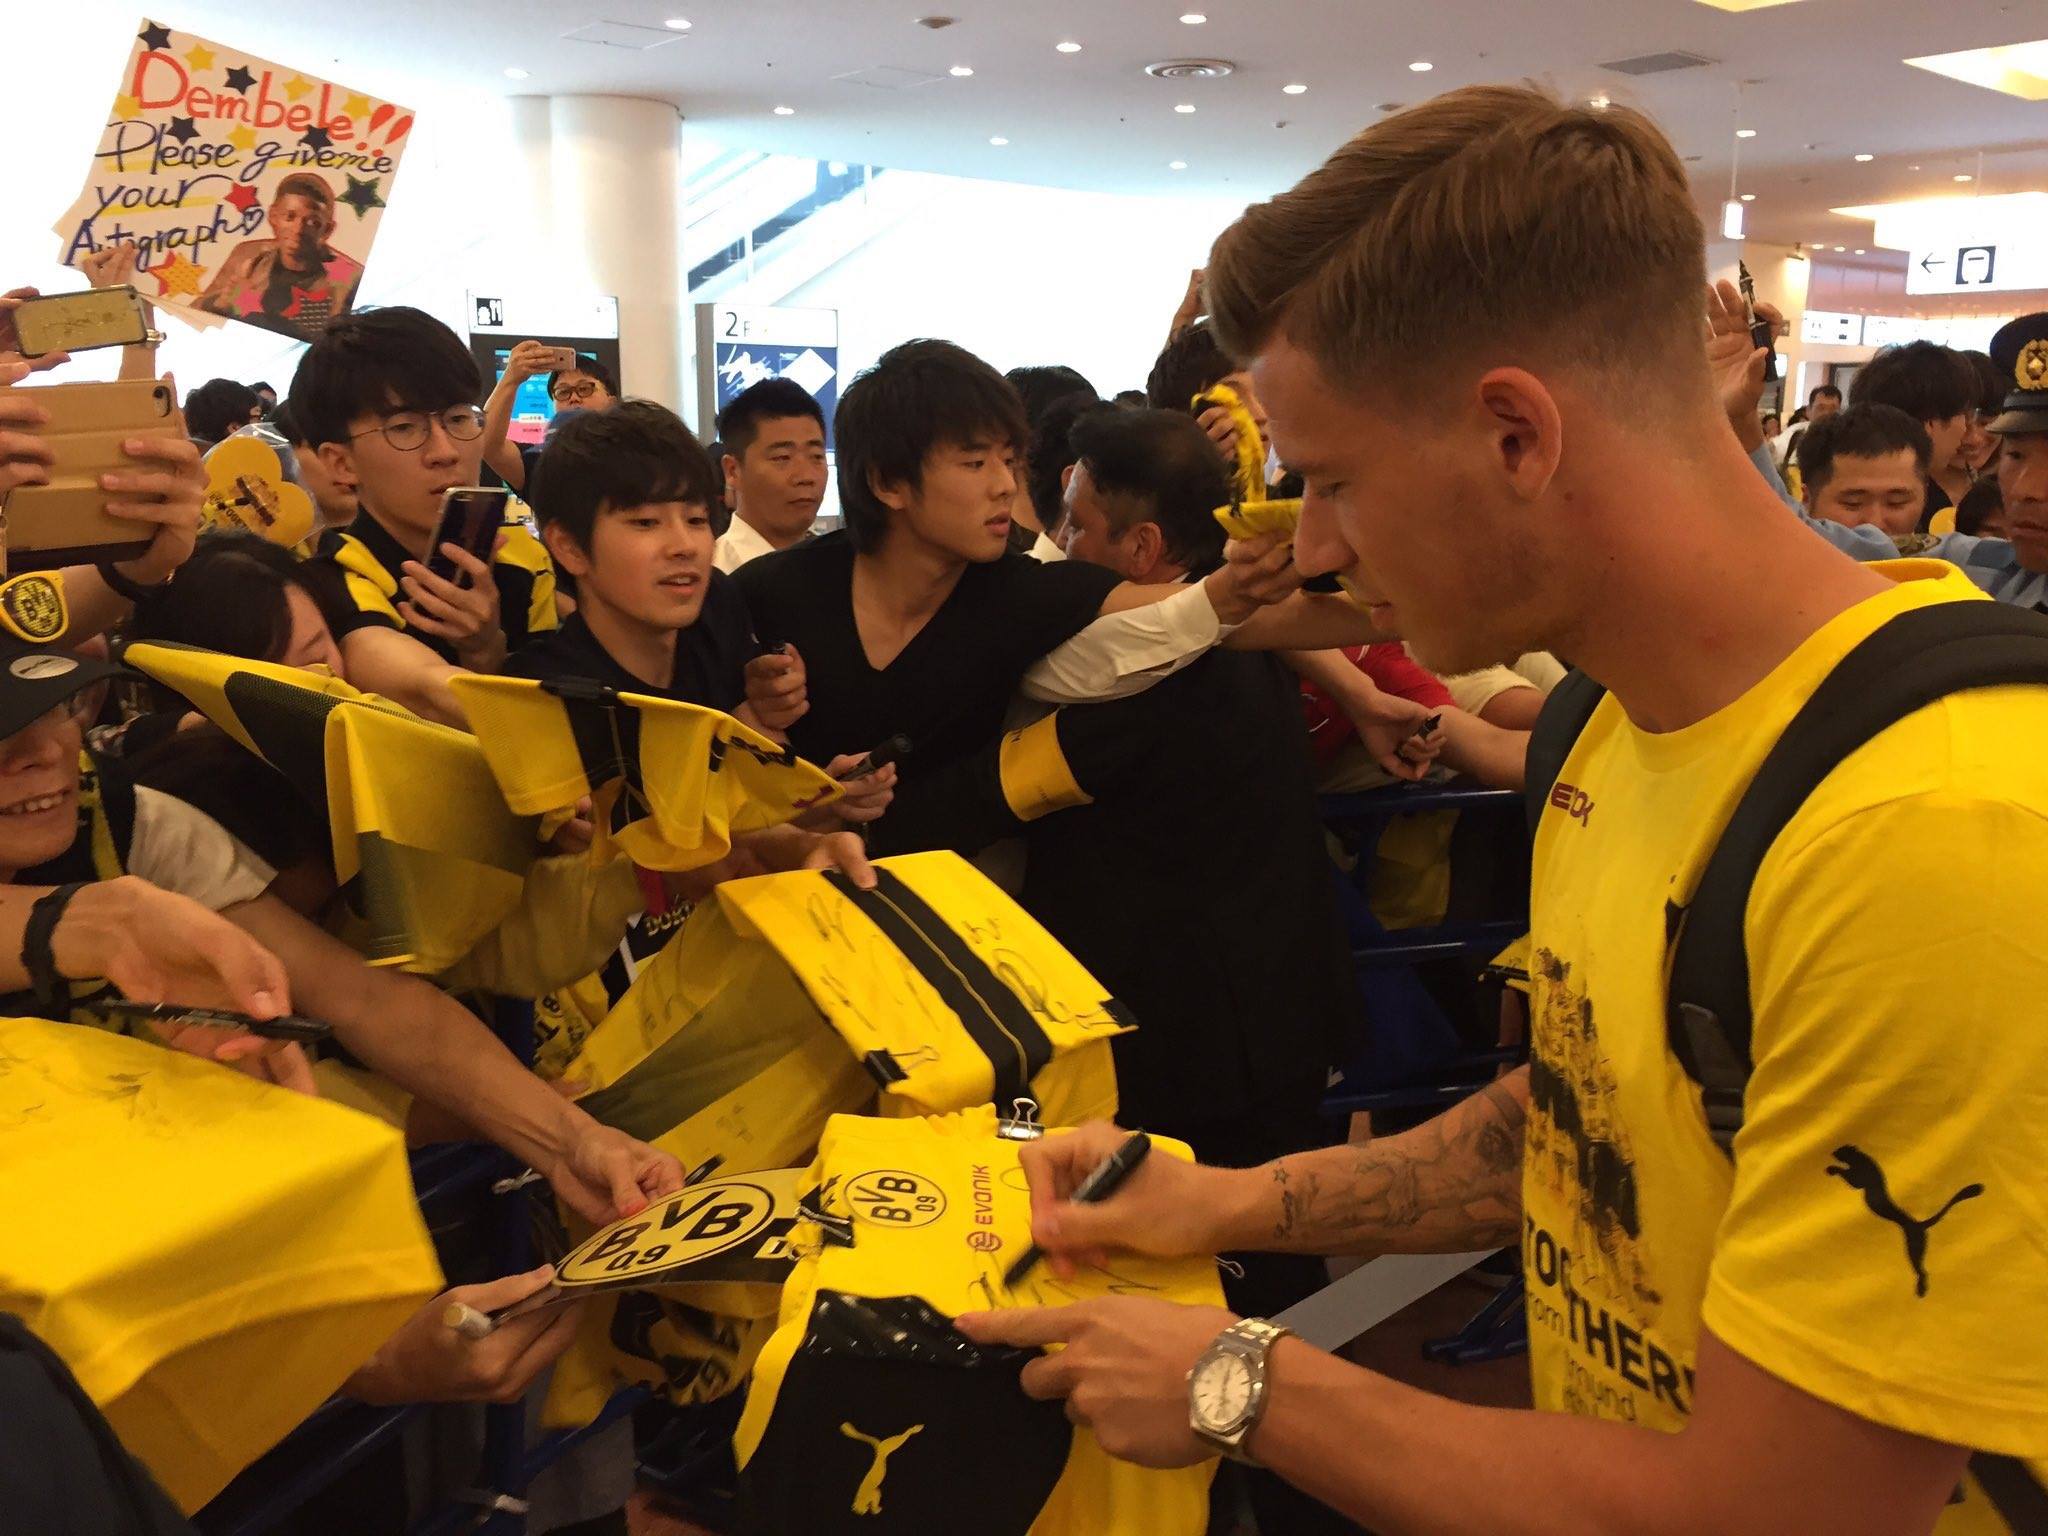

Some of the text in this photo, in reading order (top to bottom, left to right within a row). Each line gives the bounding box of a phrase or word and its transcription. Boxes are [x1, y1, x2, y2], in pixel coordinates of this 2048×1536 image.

[132, 50, 413, 158] Dembele!!
[95, 120, 240, 175] Please
[88, 173, 234, 226] your
[64, 204, 246, 273] Atgraph
[853, 1176, 918, 1223] BVB
[914, 1195, 938, 1213] 09
[972, 1164, 994, 1226] EVONIK
[579, 1190, 754, 1267] BVB
[604, 1244, 672, 1272] 09
